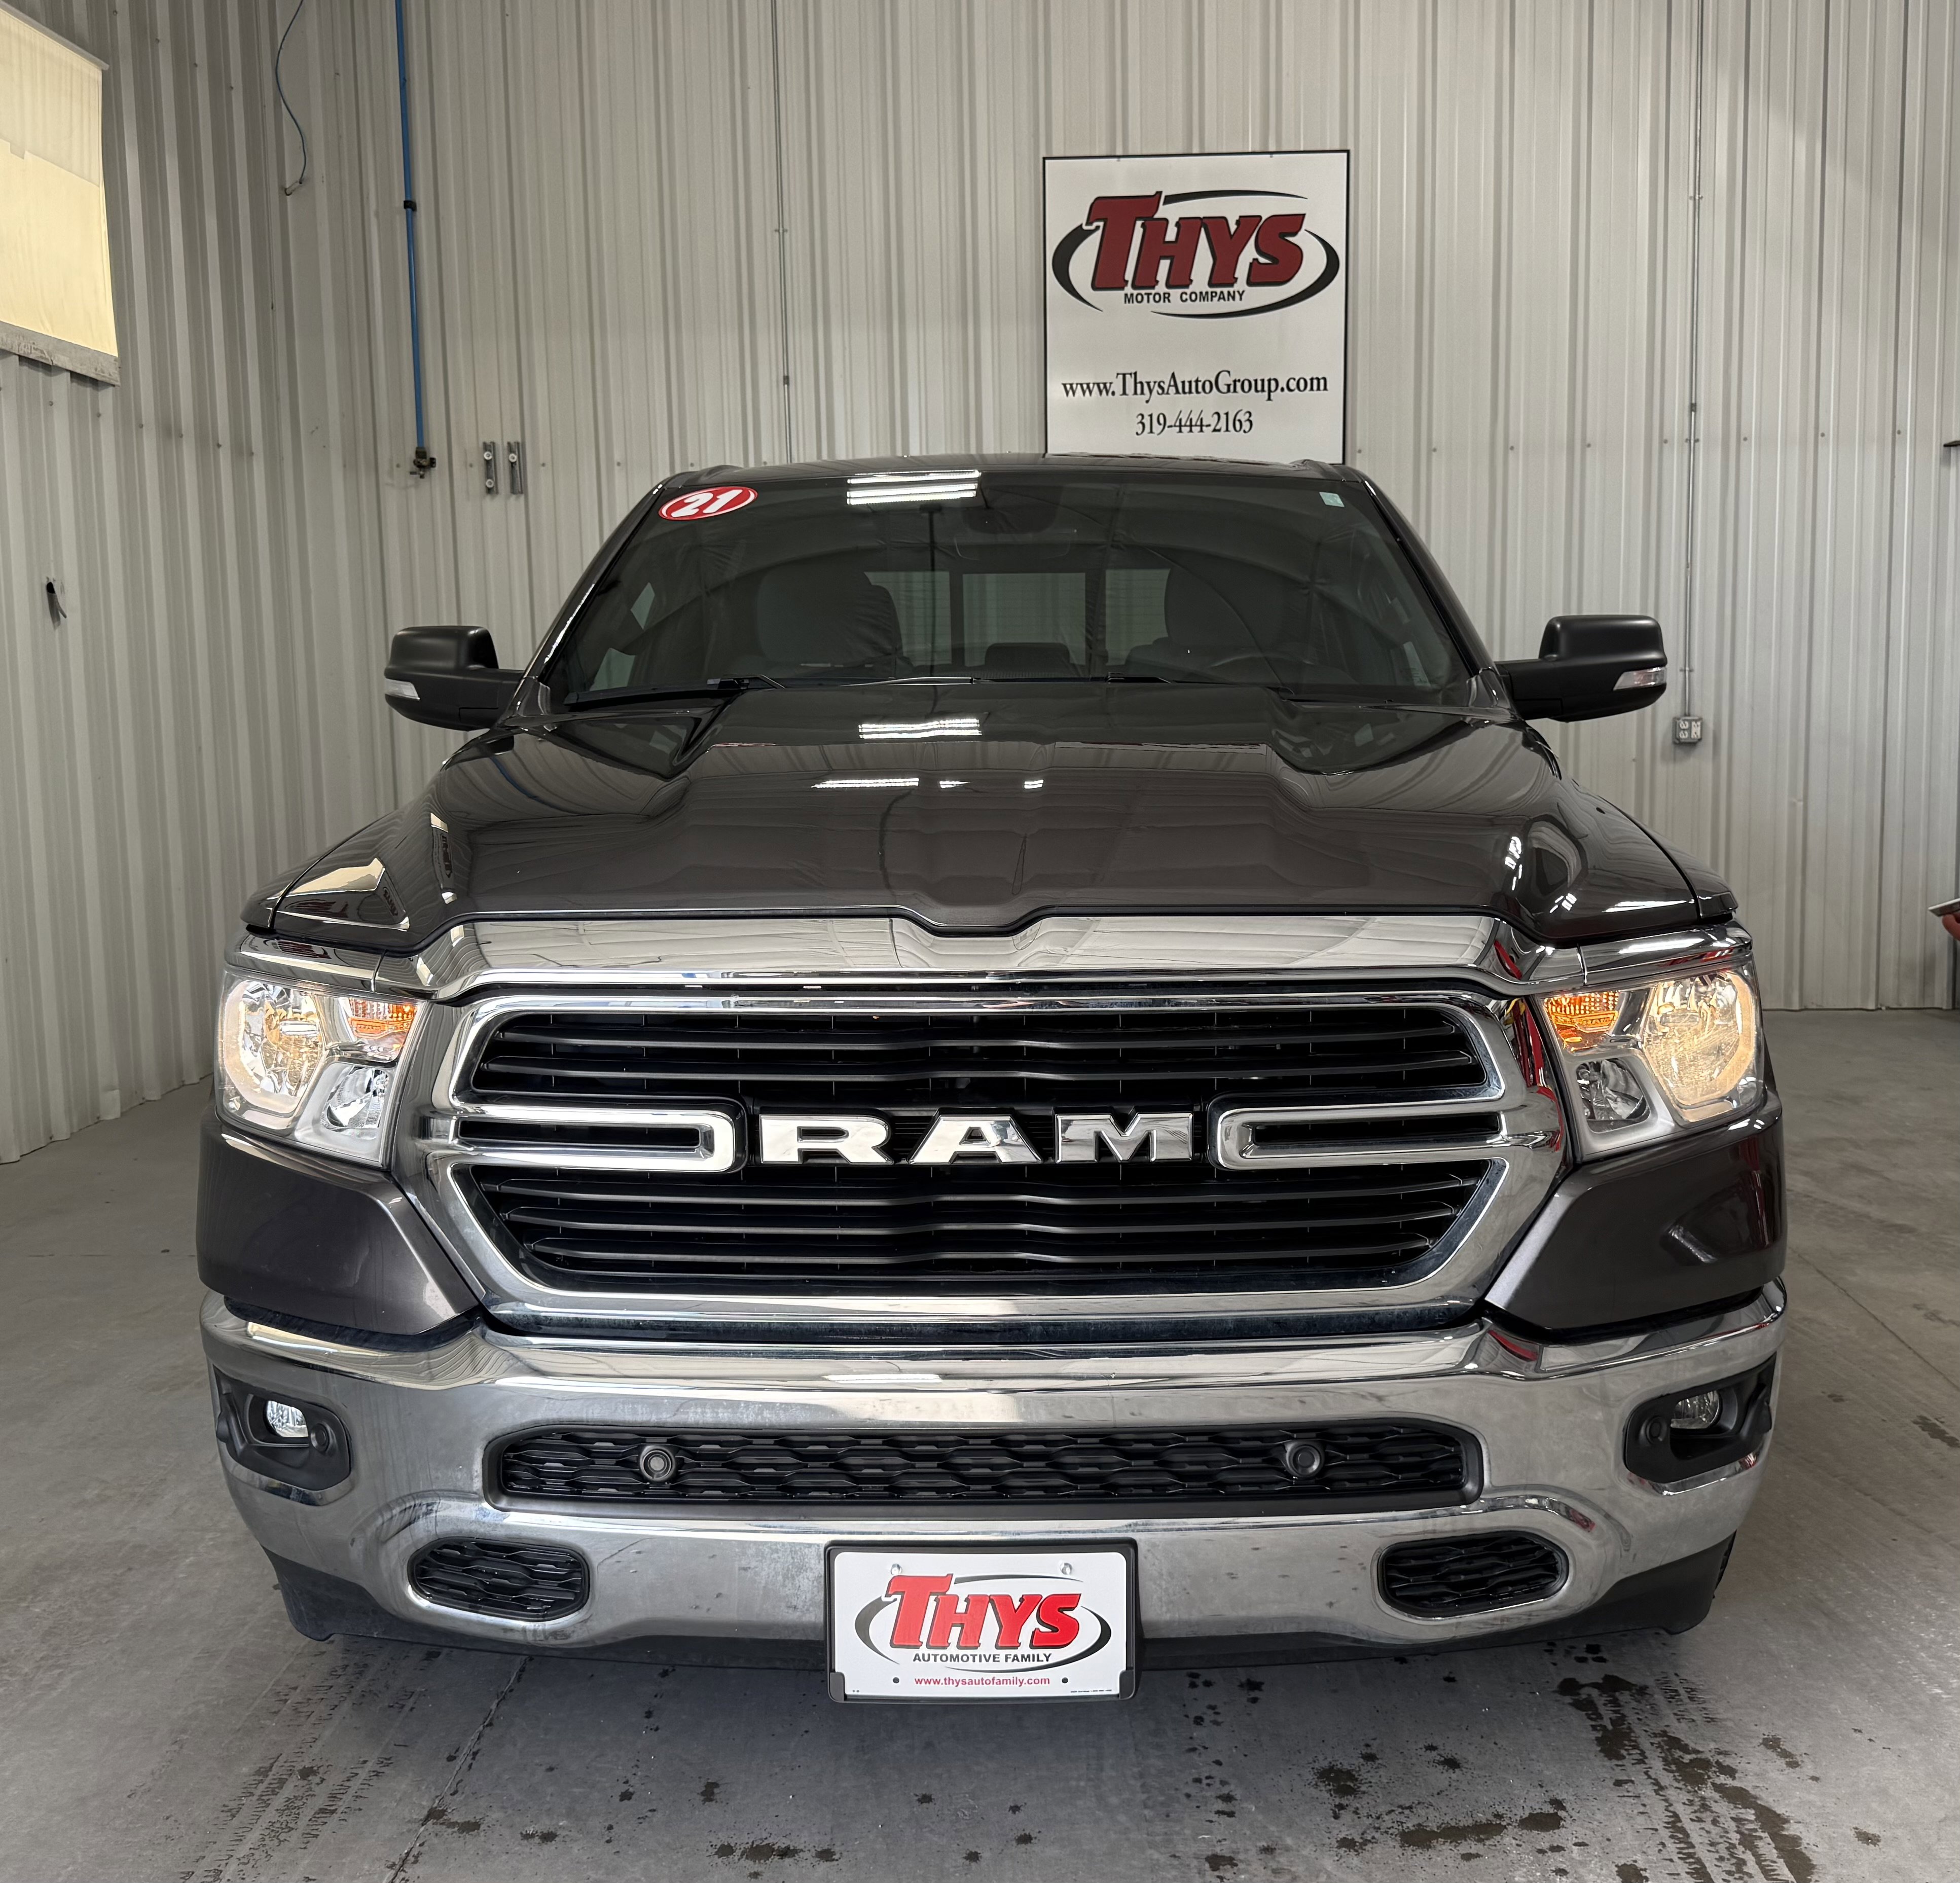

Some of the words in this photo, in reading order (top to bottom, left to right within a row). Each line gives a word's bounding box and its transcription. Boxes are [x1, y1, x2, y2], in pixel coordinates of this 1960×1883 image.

[1085, 191, 1306, 292] THYS
[1123, 292, 1171, 304] MOTOR
[1179, 291, 1245, 303] COMPANY
[1062, 370, 1328, 404] www.ThysAutoGroup.com
[1135, 409, 1253, 436] 319-444-2163
[671, 489, 743, 517] 21
[759, 1114, 1193, 1165] RAM
[885, 1573, 1081, 1649] THYS
[913, 1653, 1000, 1663] AUTOMOTIVE
[1004, 1653, 1052, 1662] FAMILY
[915, 1677, 1050, 1687] www.thysautofamily.com
